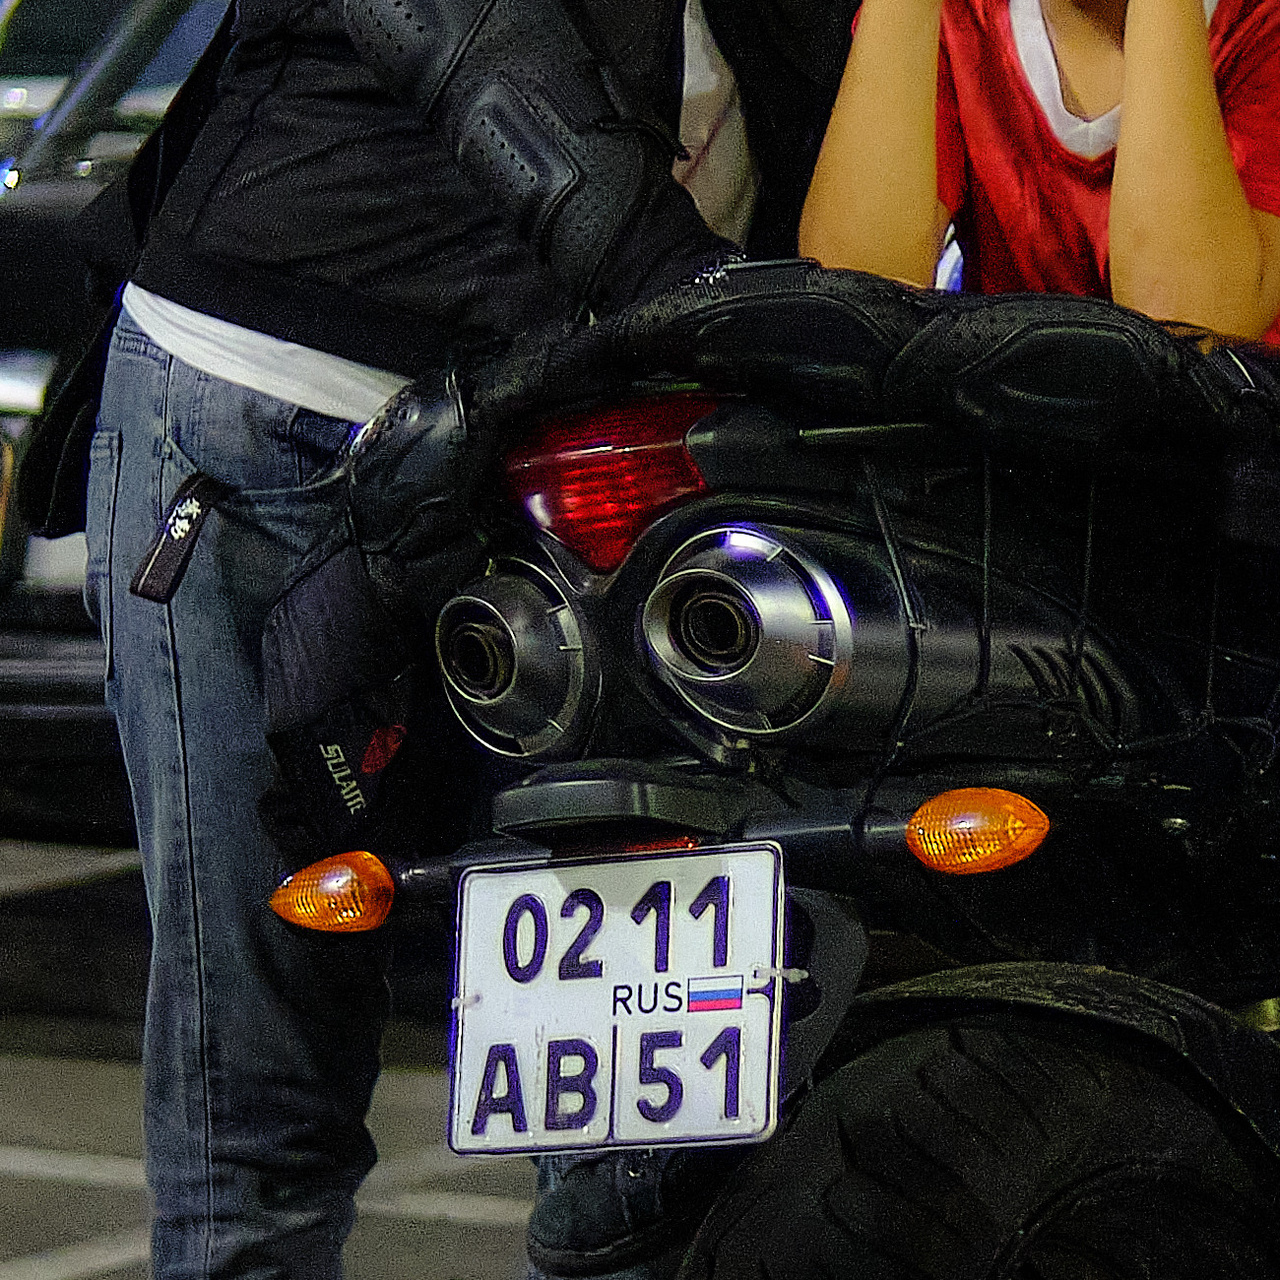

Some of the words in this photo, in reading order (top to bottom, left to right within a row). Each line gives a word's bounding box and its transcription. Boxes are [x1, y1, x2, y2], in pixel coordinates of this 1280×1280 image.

[502, 875, 731, 984] 0211
[612, 981, 683, 1016] RUS
[471, 1038, 600, 1136] AB
[636, 1026, 741, 1123] 51
